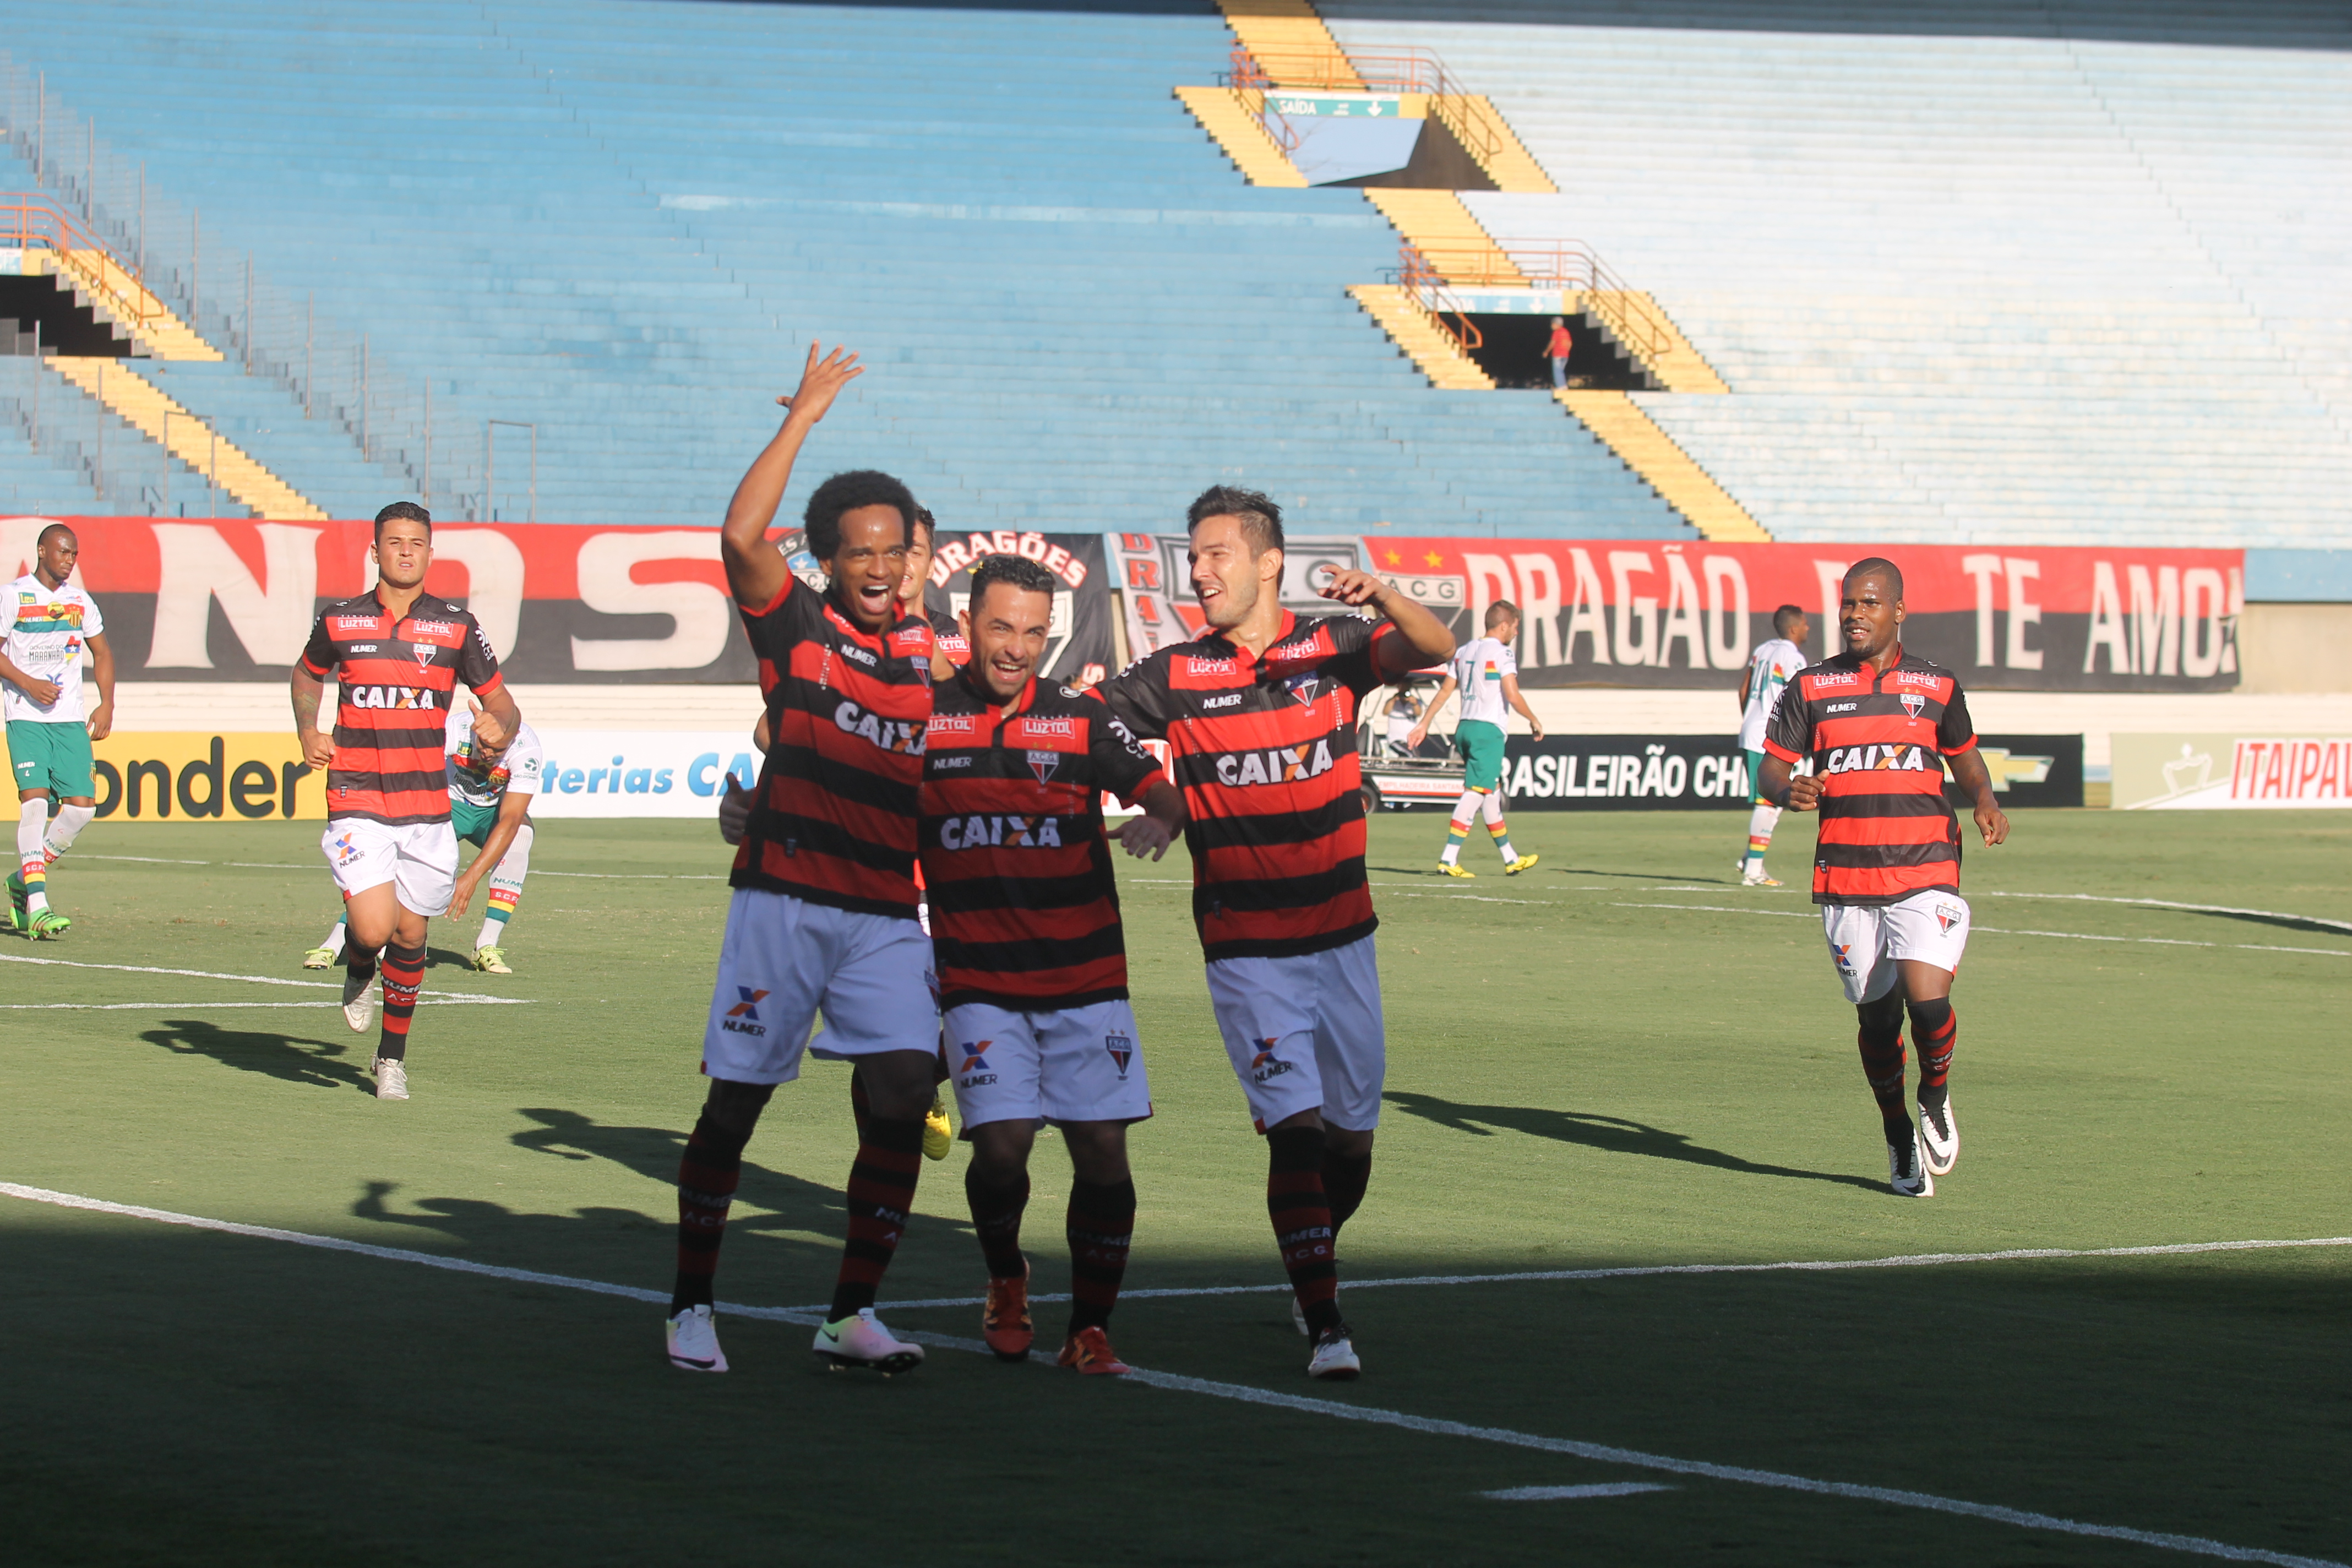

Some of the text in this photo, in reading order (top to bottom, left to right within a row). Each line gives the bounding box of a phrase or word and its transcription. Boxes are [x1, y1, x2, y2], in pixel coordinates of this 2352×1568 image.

[1278, 99, 1316, 115] SAÍDA
[930, 530, 1088, 589] DRAGÕES
[20, 593, 35, 603] Leo
[1462, 545, 1752, 671] DRAGÃO
[1963, 554, 2043, 670] TE
[340, 619, 375, 629] LUZTOL
[415, 623, 451, 634] LUZTOL
[29, 649, 64, 661] MARANHÃO
[350, 645, 378, 653] NUMER
[841, 644, 877, 667] NUMER
[1465, 661, 1476, 693] 7
[1816, 676, 1854, 687] LUZTOL
[1900, 675, 1937, 688] LUZTOL
[352, 686, 435, 710] CAIXA
[1202, 694, 1242, 709] NUMER
[1826, 703, 1857, 714] NUMER
[1025, 721, 1072, 734] LUZTOL
[933, 756, 972, 770] NUMER
[1216, 739, 1333, 786] CAIXA
[1827, 745, 1924, 774] CAIXA
[1379, 781, 1430, 790] EMPILHADEIRA
[940, 815, 1061, 850] CAIXA
[339, 851, 366, 868] NUMER
[722, 1020, 767, 1037] NUMER
[1254, 1061, 1293, 1084] NUMER
[960, 1074, 998, 1090] NUMER
